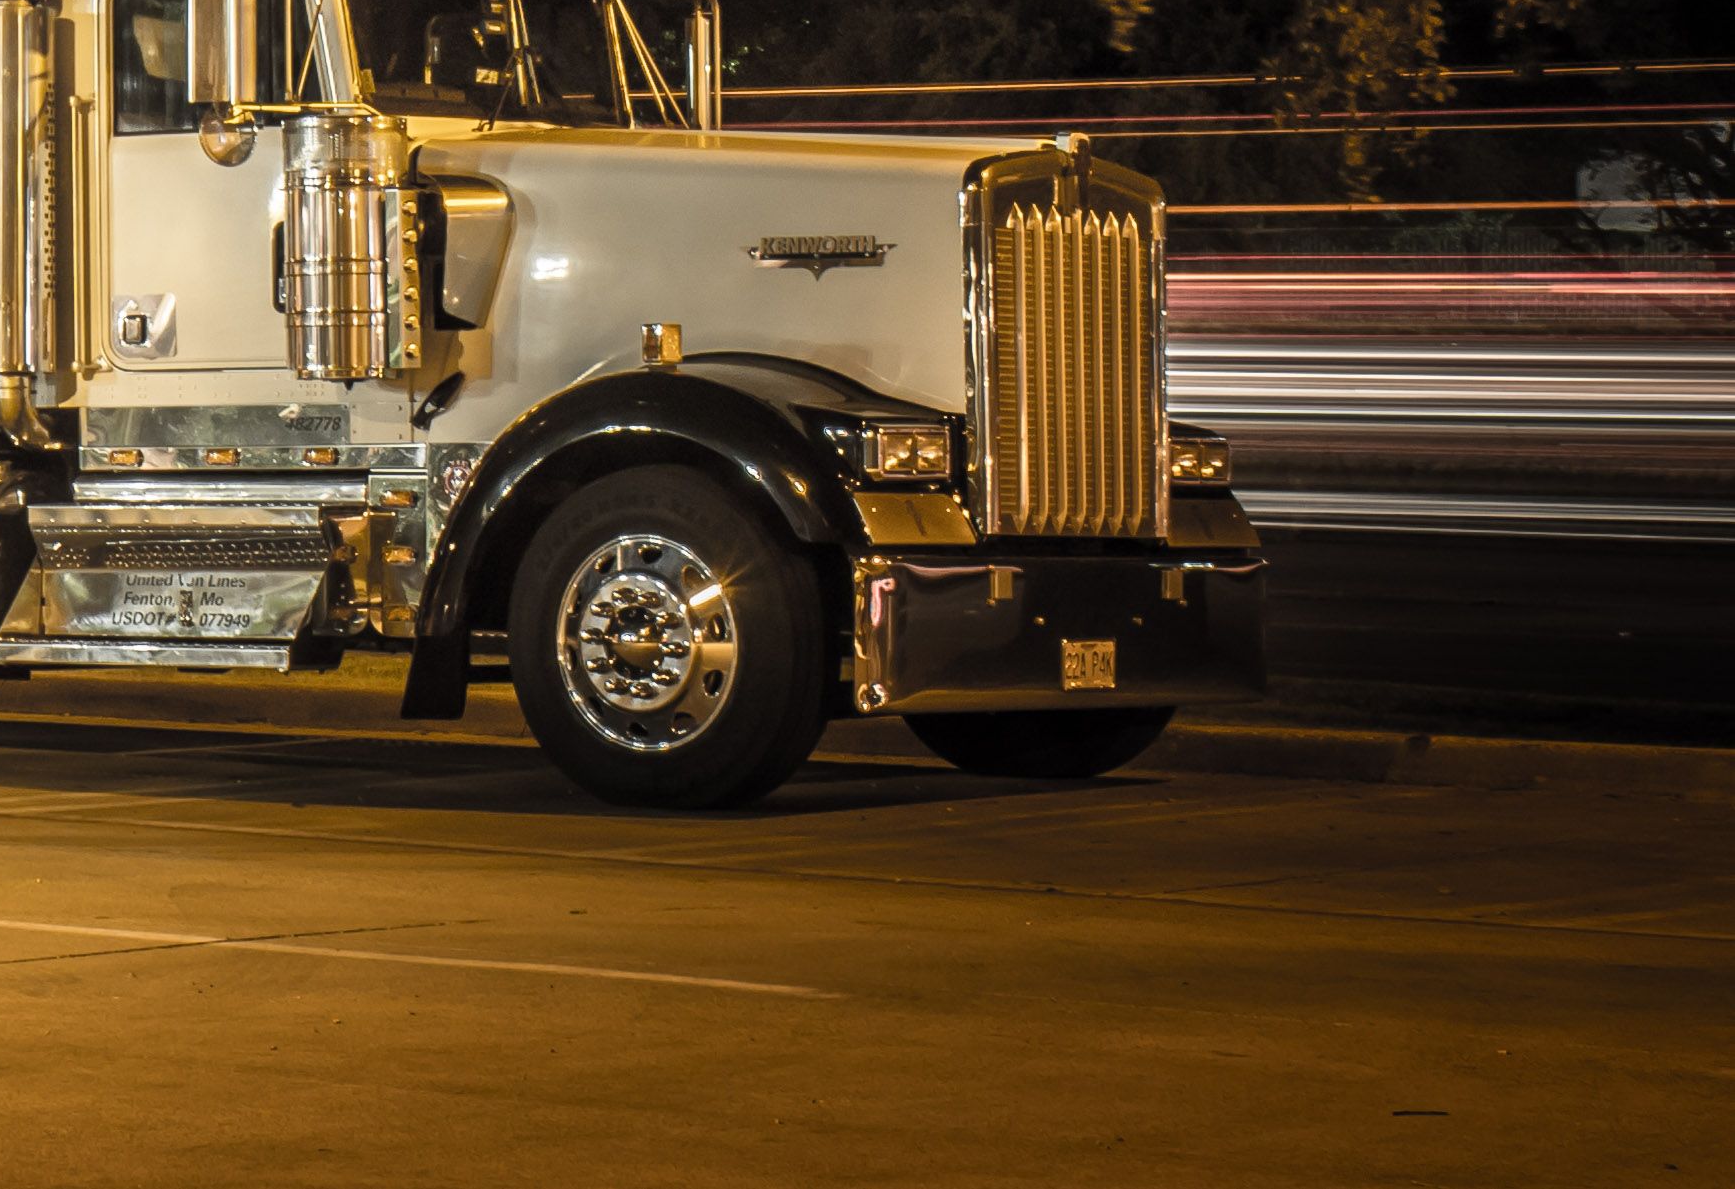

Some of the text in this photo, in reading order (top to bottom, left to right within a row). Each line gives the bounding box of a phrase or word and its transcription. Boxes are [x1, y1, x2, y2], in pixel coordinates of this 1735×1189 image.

[759, 235, 876, 254] KENWORTH
[126, 574, 173, 587] United
[207, 574, 246, 588] Lines
[199, 592, 224, 606] Mo
[199, 613, 250, 628] 077949
